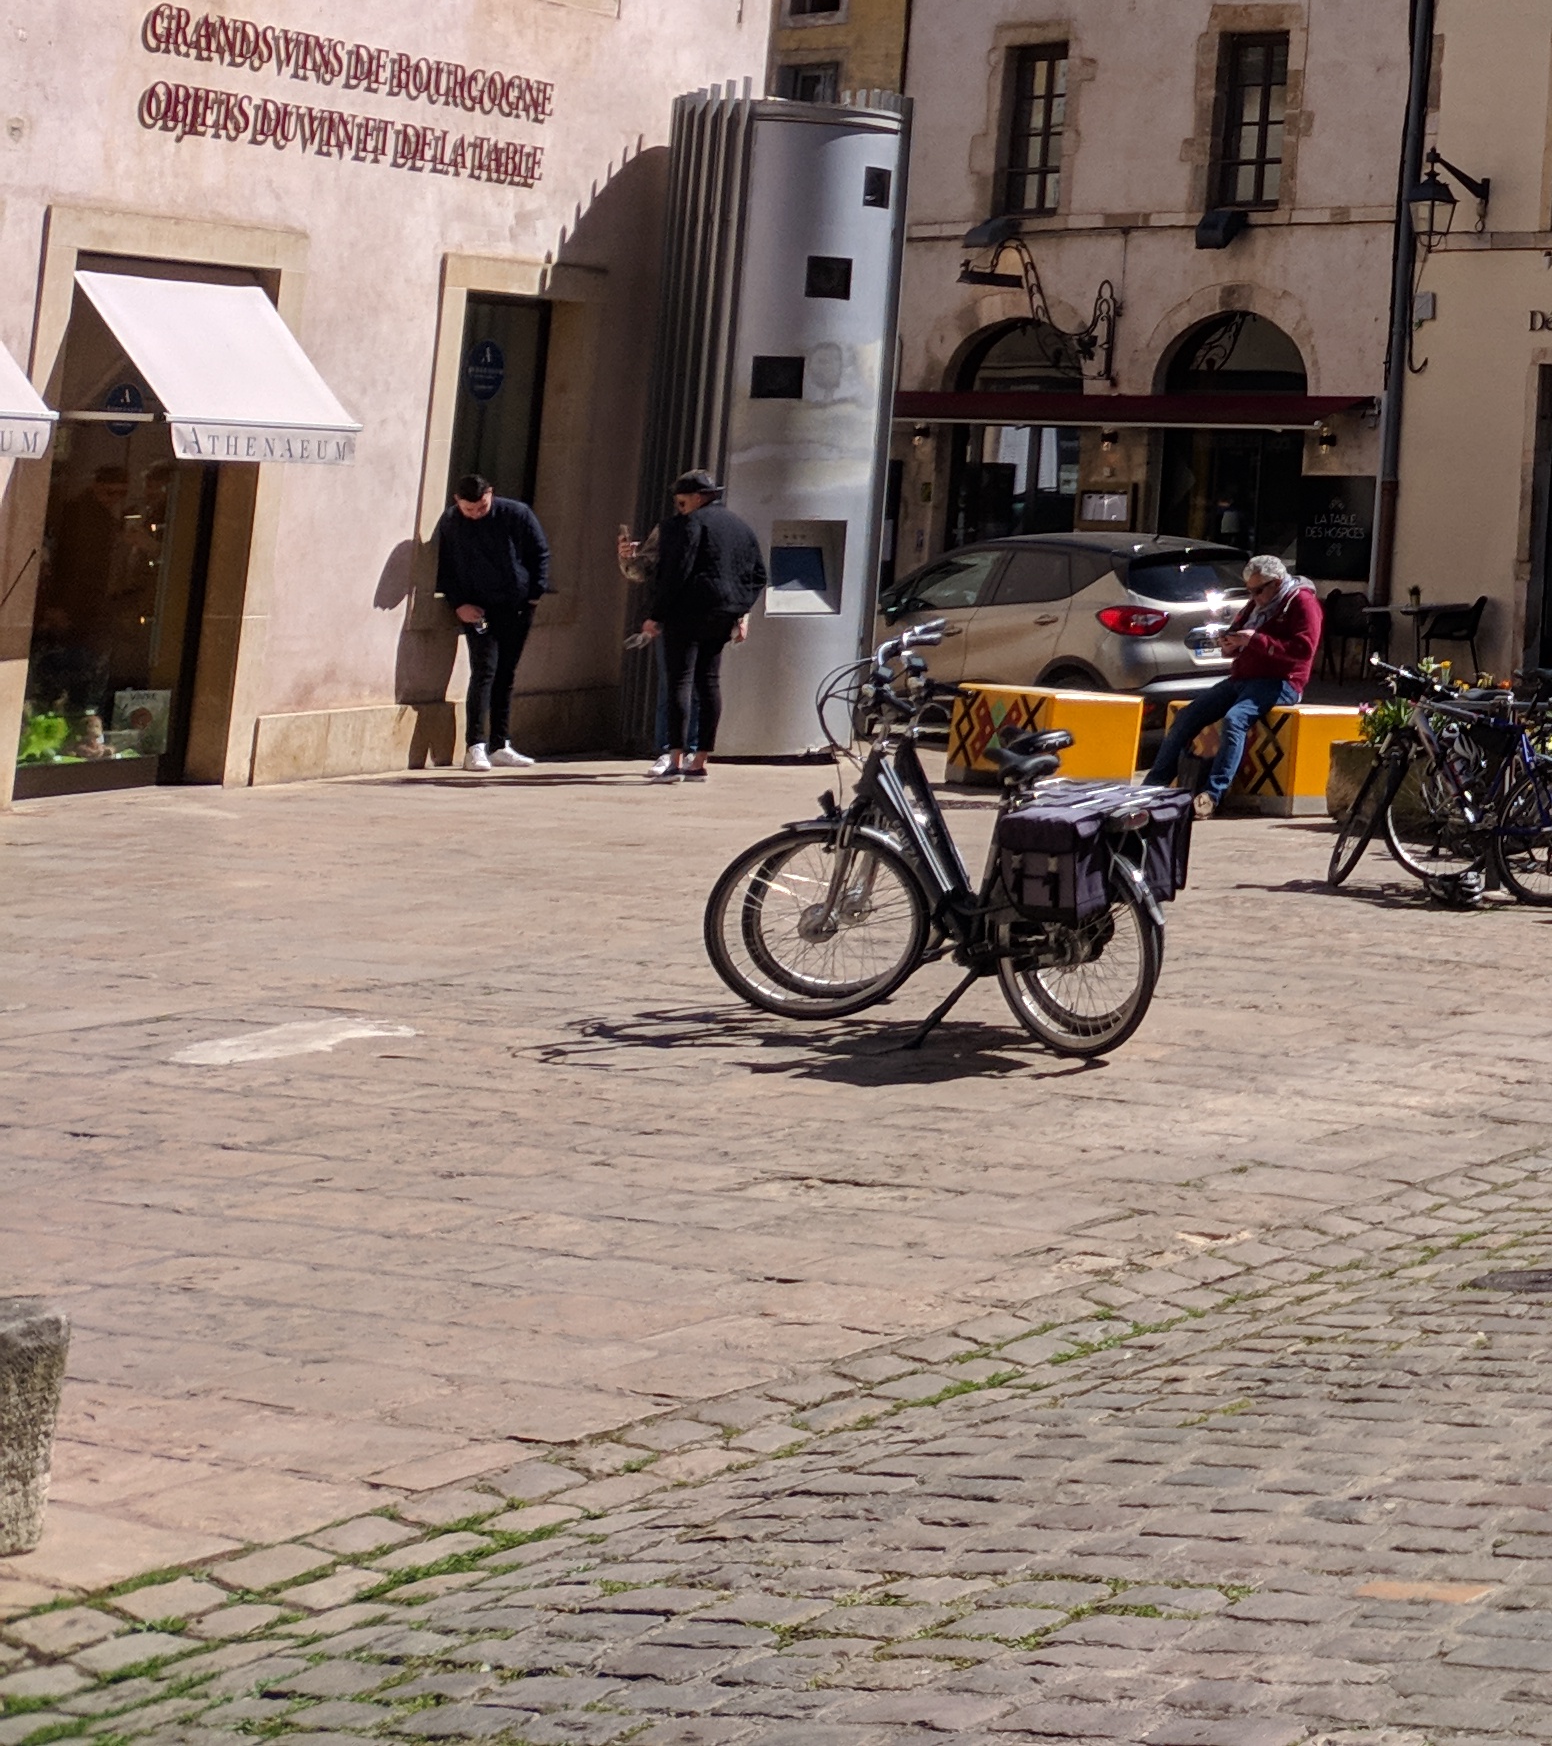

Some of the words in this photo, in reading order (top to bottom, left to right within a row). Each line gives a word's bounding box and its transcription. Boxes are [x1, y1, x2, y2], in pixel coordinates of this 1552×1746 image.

[148, 2, 274, 65] GRANDS
[279, 28, 346, 78] VINS
[352, 43, 390, 86] DE
[395, 52, 555, 119] BOURGOGNE
[144, 80, 254, 136] OBJETS
[259, 97, 301, 143] DU
[303, 105, 359, 152] VIN
[362, 115, 396, 158] ET
[400, 123, 435, 165] DE
[436, 129, 469, 171] LA
[474, 134, 546, 182] TABLE
[181, 426, 350, 462] ATHENAEUM
[1305, 526, 1322, 537] DES
[1324, 527, 1365, 539] HOSPICES
[1315, 514, 1327, 524] LA
[1330, 514, 1357, 525] TABLE
